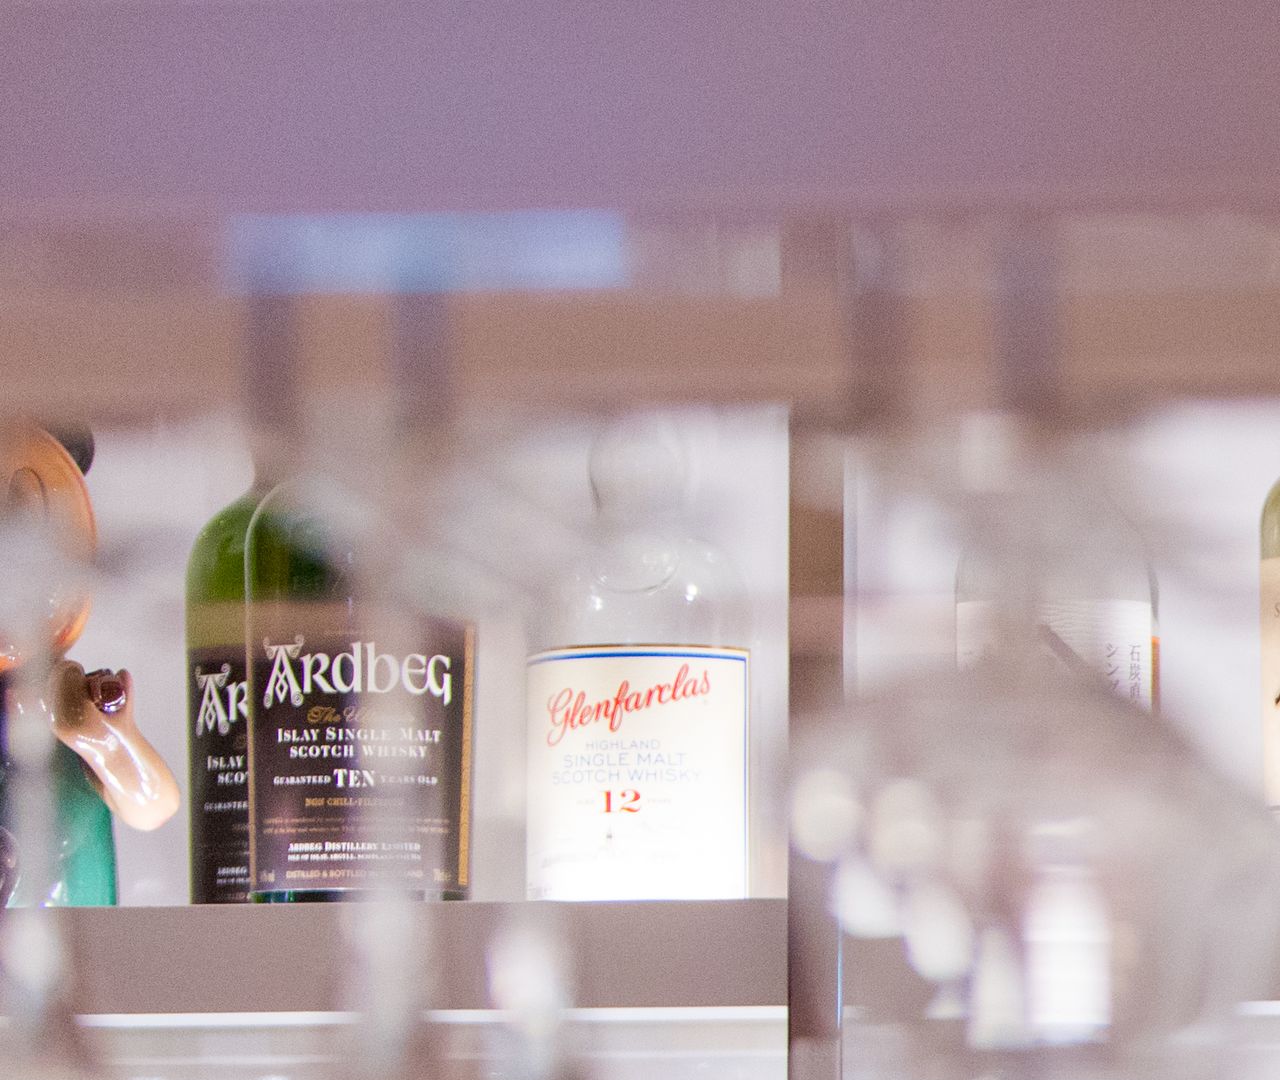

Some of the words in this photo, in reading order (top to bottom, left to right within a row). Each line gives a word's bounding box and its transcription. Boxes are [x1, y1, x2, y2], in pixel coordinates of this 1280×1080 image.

[547, 663, 710, 747] Glenfarclas
[277, 728, 320, 743] ISLAY
[325, 726, 391, 742] SINGLE
[401, 728, 441, 743] MALT
[290, 746, 354, 758] SCOTCH
[362, 746, 428, 758] WHISKY
[585, 740, 661, 751] HIGHLAND
[207, 755, 245, 771] ISLAY
[563, 753, 630, 768] SINGLE
[636, 752, 687, 765] MALT
[273, 774, 331, 785] GUARANTEED
[333, 768, 376, 788] TEN
[417, 775, 439, 785] OLD
[552, 769, 620, 786] SCOTCH
[626, 768, 701, 781] WHISKY
[602, 789, 641, 813] 12
